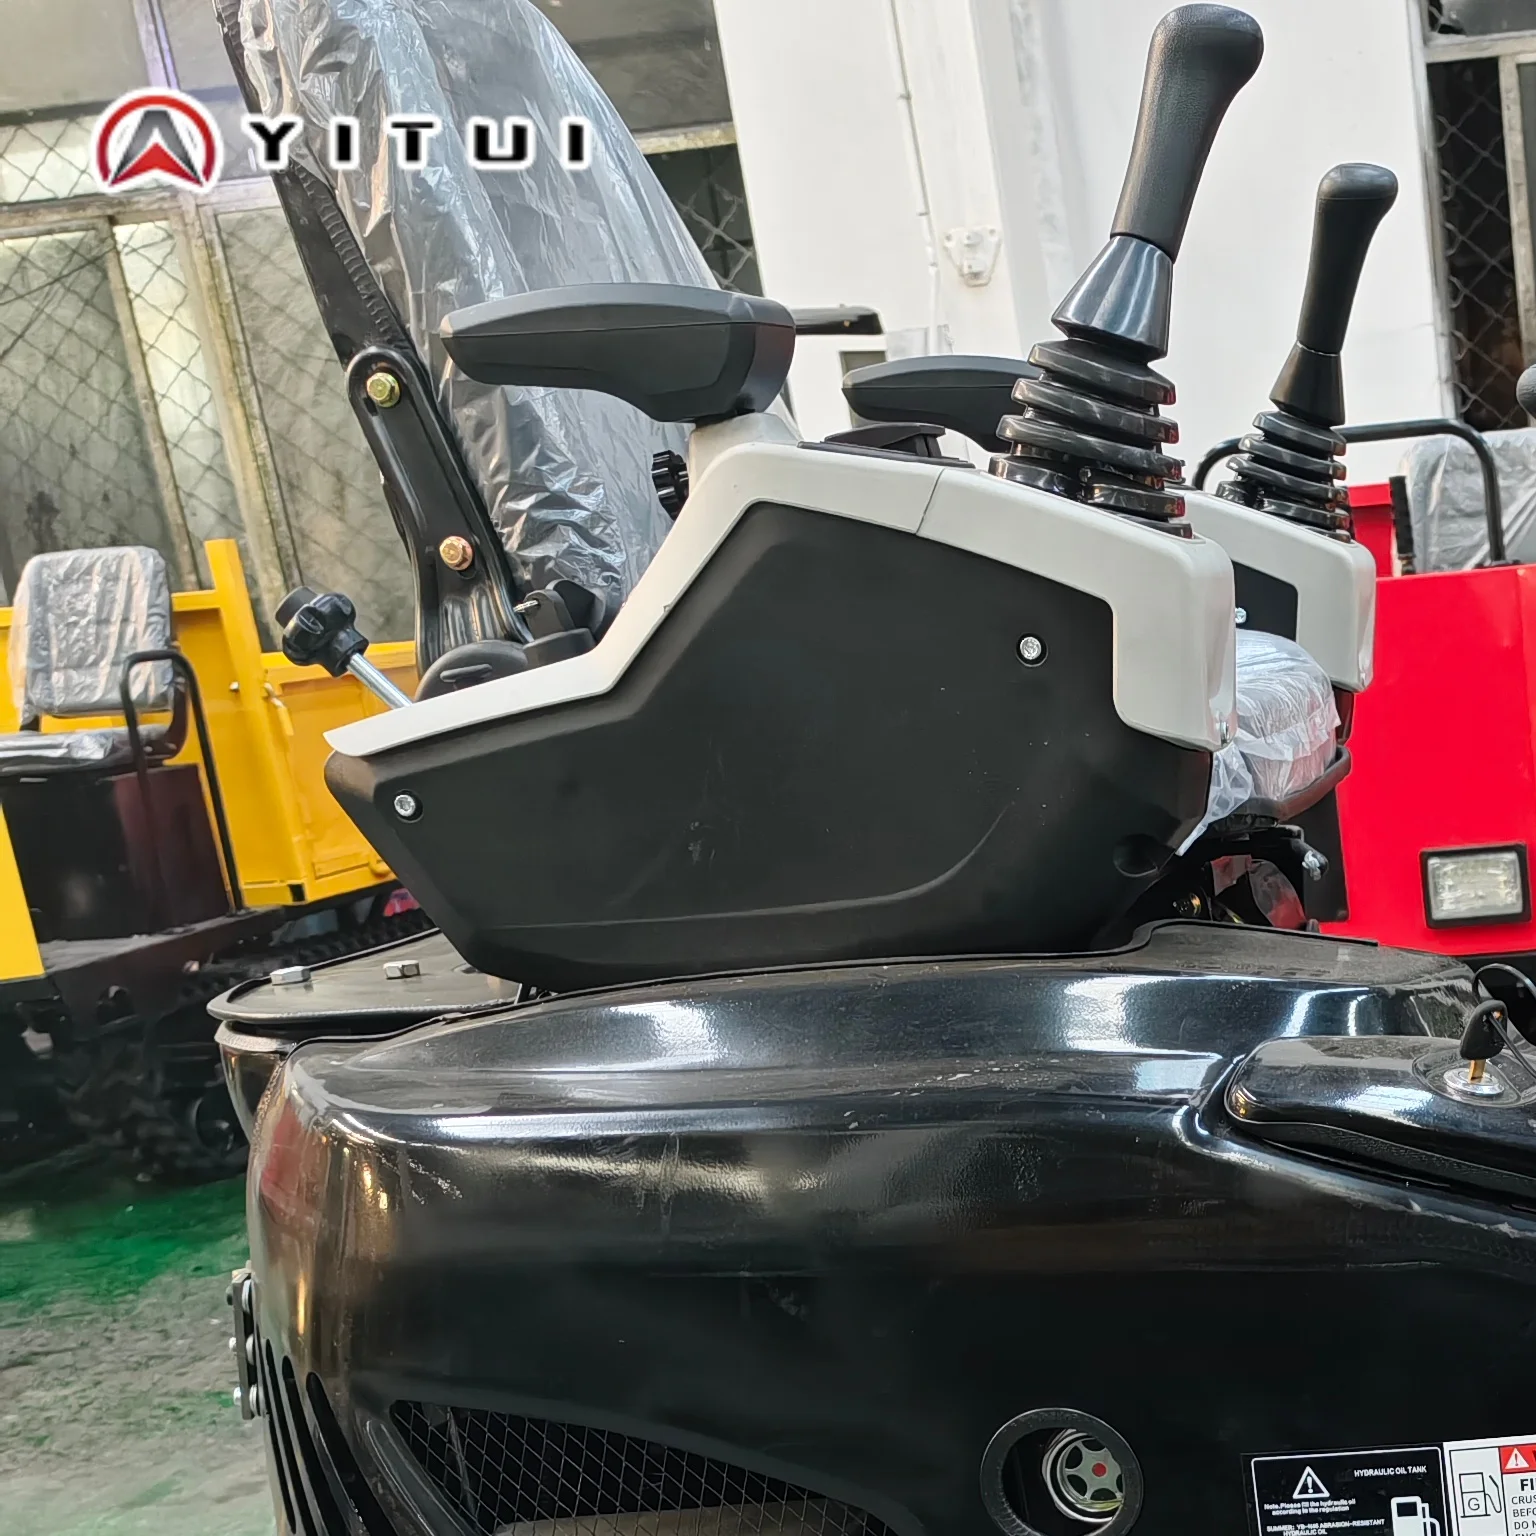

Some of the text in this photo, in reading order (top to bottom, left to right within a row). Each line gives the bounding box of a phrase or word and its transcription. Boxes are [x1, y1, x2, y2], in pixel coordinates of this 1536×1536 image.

[1354, 1466, 1427, 1477] HYDRAULIC OIL TANK
[1468, 1498, 1480, 1511] G
[1272, 1507, 1301, 1516] according
[1319, 1505, 1349, 1514] regulation
[1267, 1524, 1295, 1532] SUMMER:
[1514, 1520, 1528, 1530] DO
